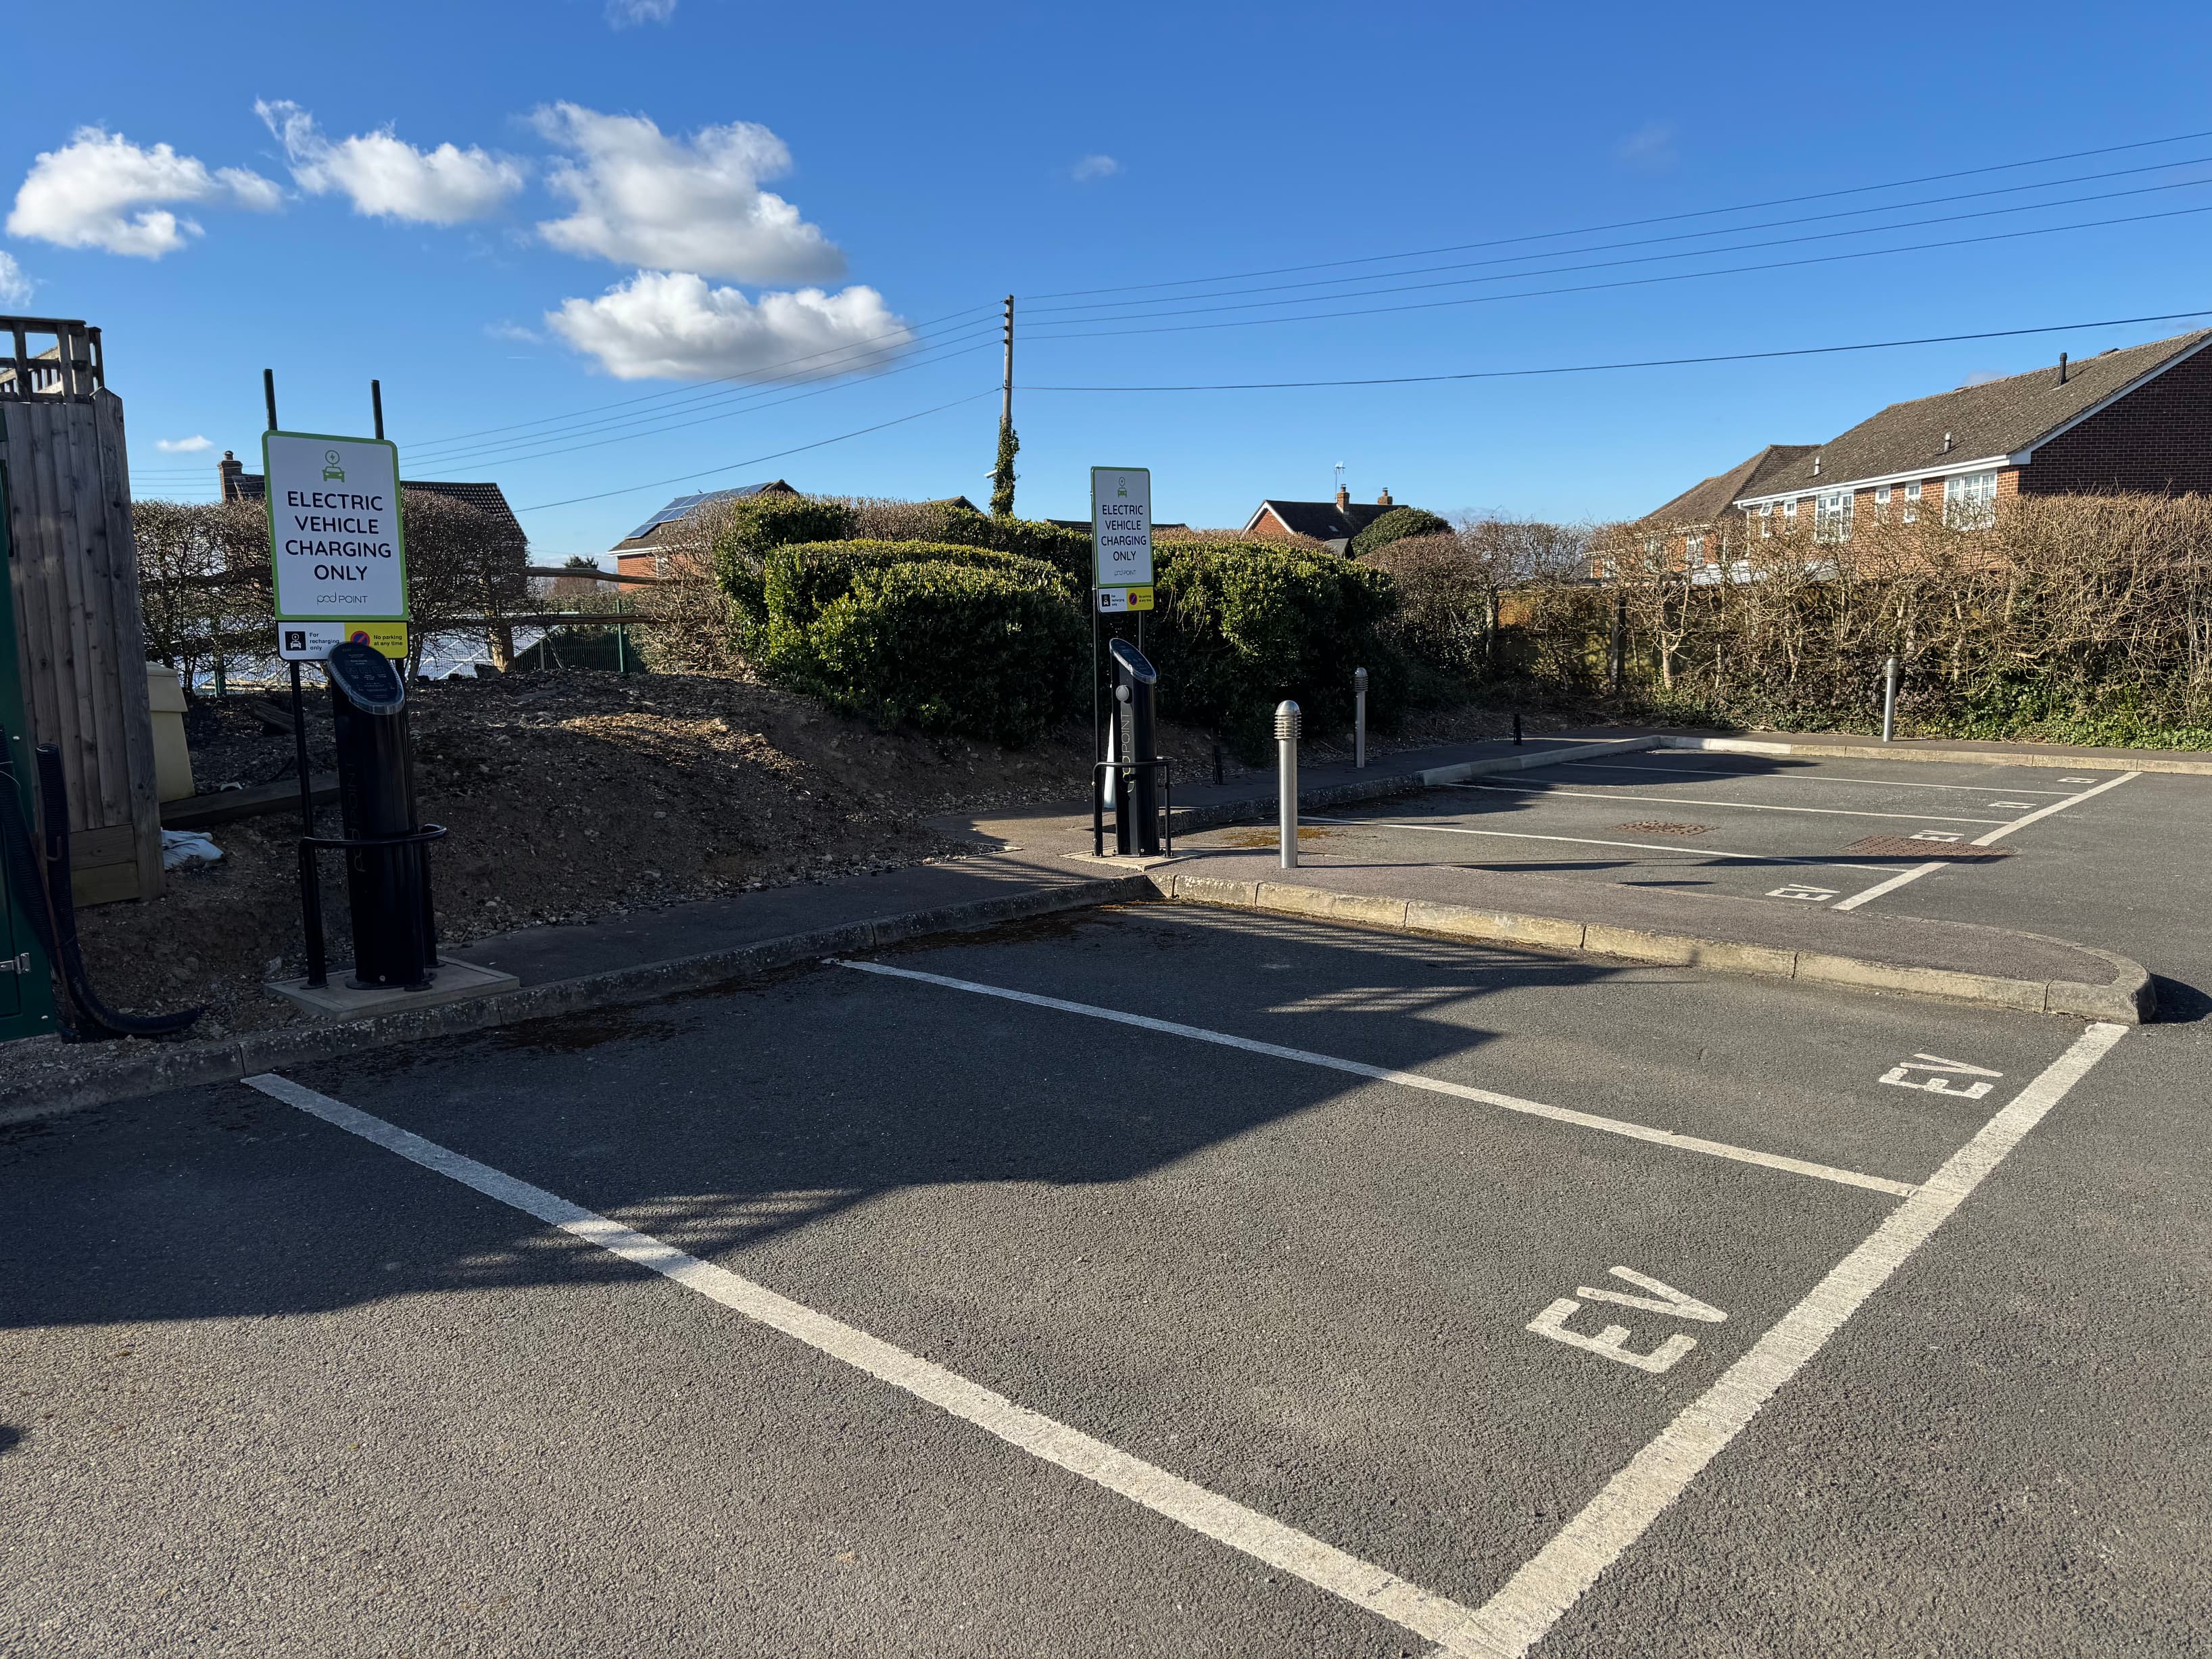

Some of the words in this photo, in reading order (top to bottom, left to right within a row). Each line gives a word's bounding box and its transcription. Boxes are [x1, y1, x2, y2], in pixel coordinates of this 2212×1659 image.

[287, 491, 383, 511] ELECTRIC
[1102, 504, 1143, 515] ELECTRIC
[295, 515, 379, 534] VEHICLE
[1105, 520, 1142, 531] VEHICLE
[285, 539, 391, 558] CHARGING
[1101, 535, 1147, 546] CHARGING
[1113, 551, 1136, 561] ONLY
[314, 564, 368, 581] ONLY
[316, 592, 337, 606] pod
[339, 595, 368, 604] POINT
[1120, 714, 1131, 752] POINT
[346, 762, 359, 823] POINT
[1908, 830, 1965, 842] EV
[1764, 884, 1841, 901] EV
[1878, 1053, 2004, 1099] EV
[1525, 1266, 1729, 1374] EV
